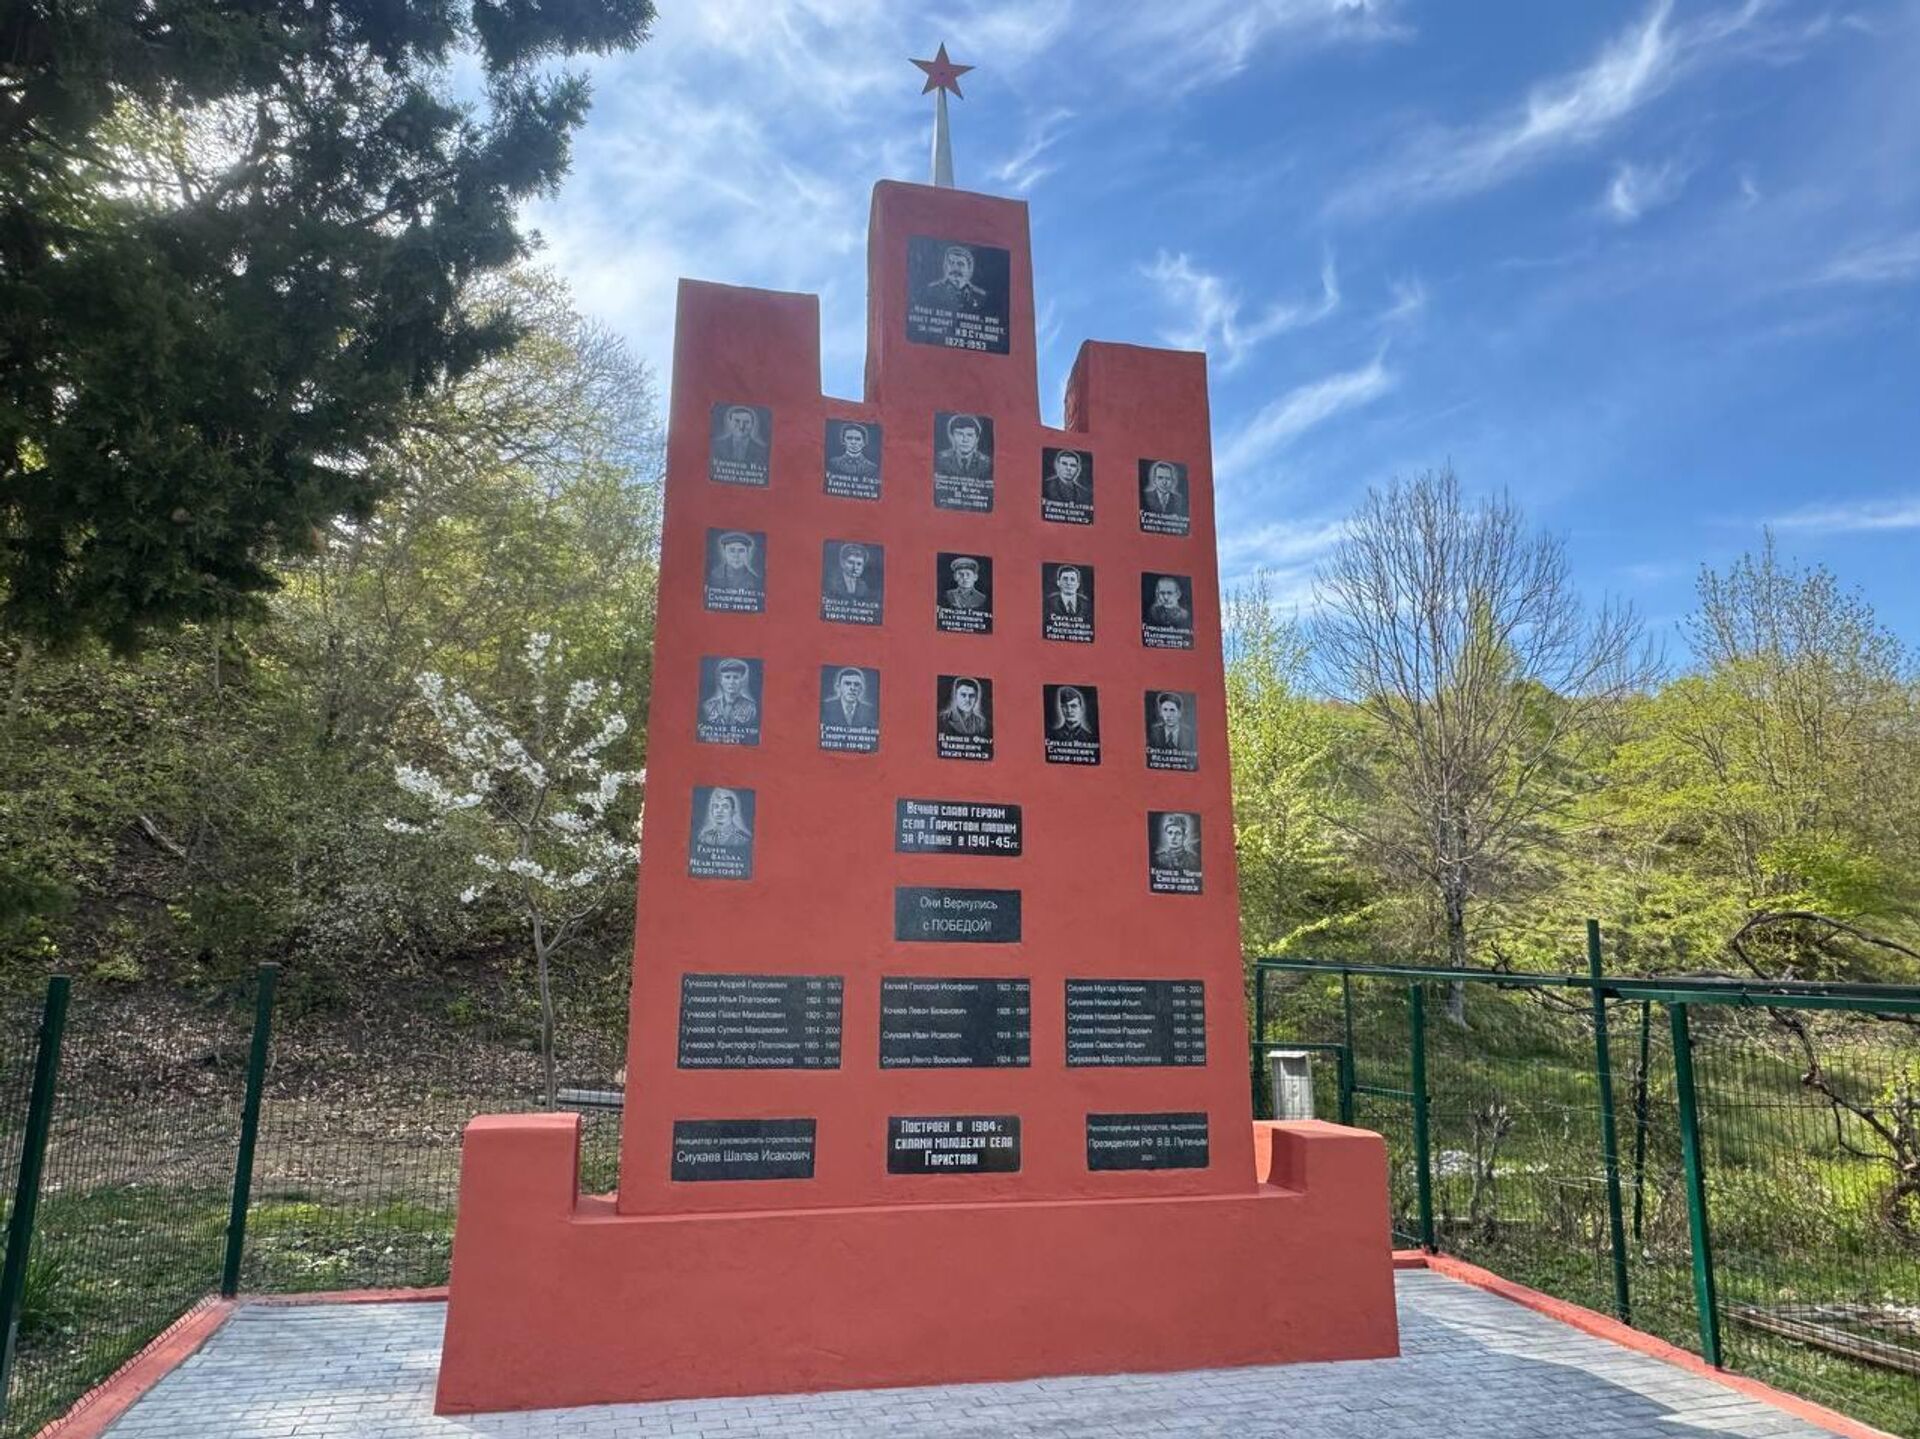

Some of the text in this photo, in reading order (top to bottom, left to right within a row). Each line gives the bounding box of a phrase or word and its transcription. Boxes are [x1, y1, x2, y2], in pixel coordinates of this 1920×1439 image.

[920, 896, 998, 911] Они Вернулись
[677, 1149, 810, 1165] Сиукаев Шалва Исакович
